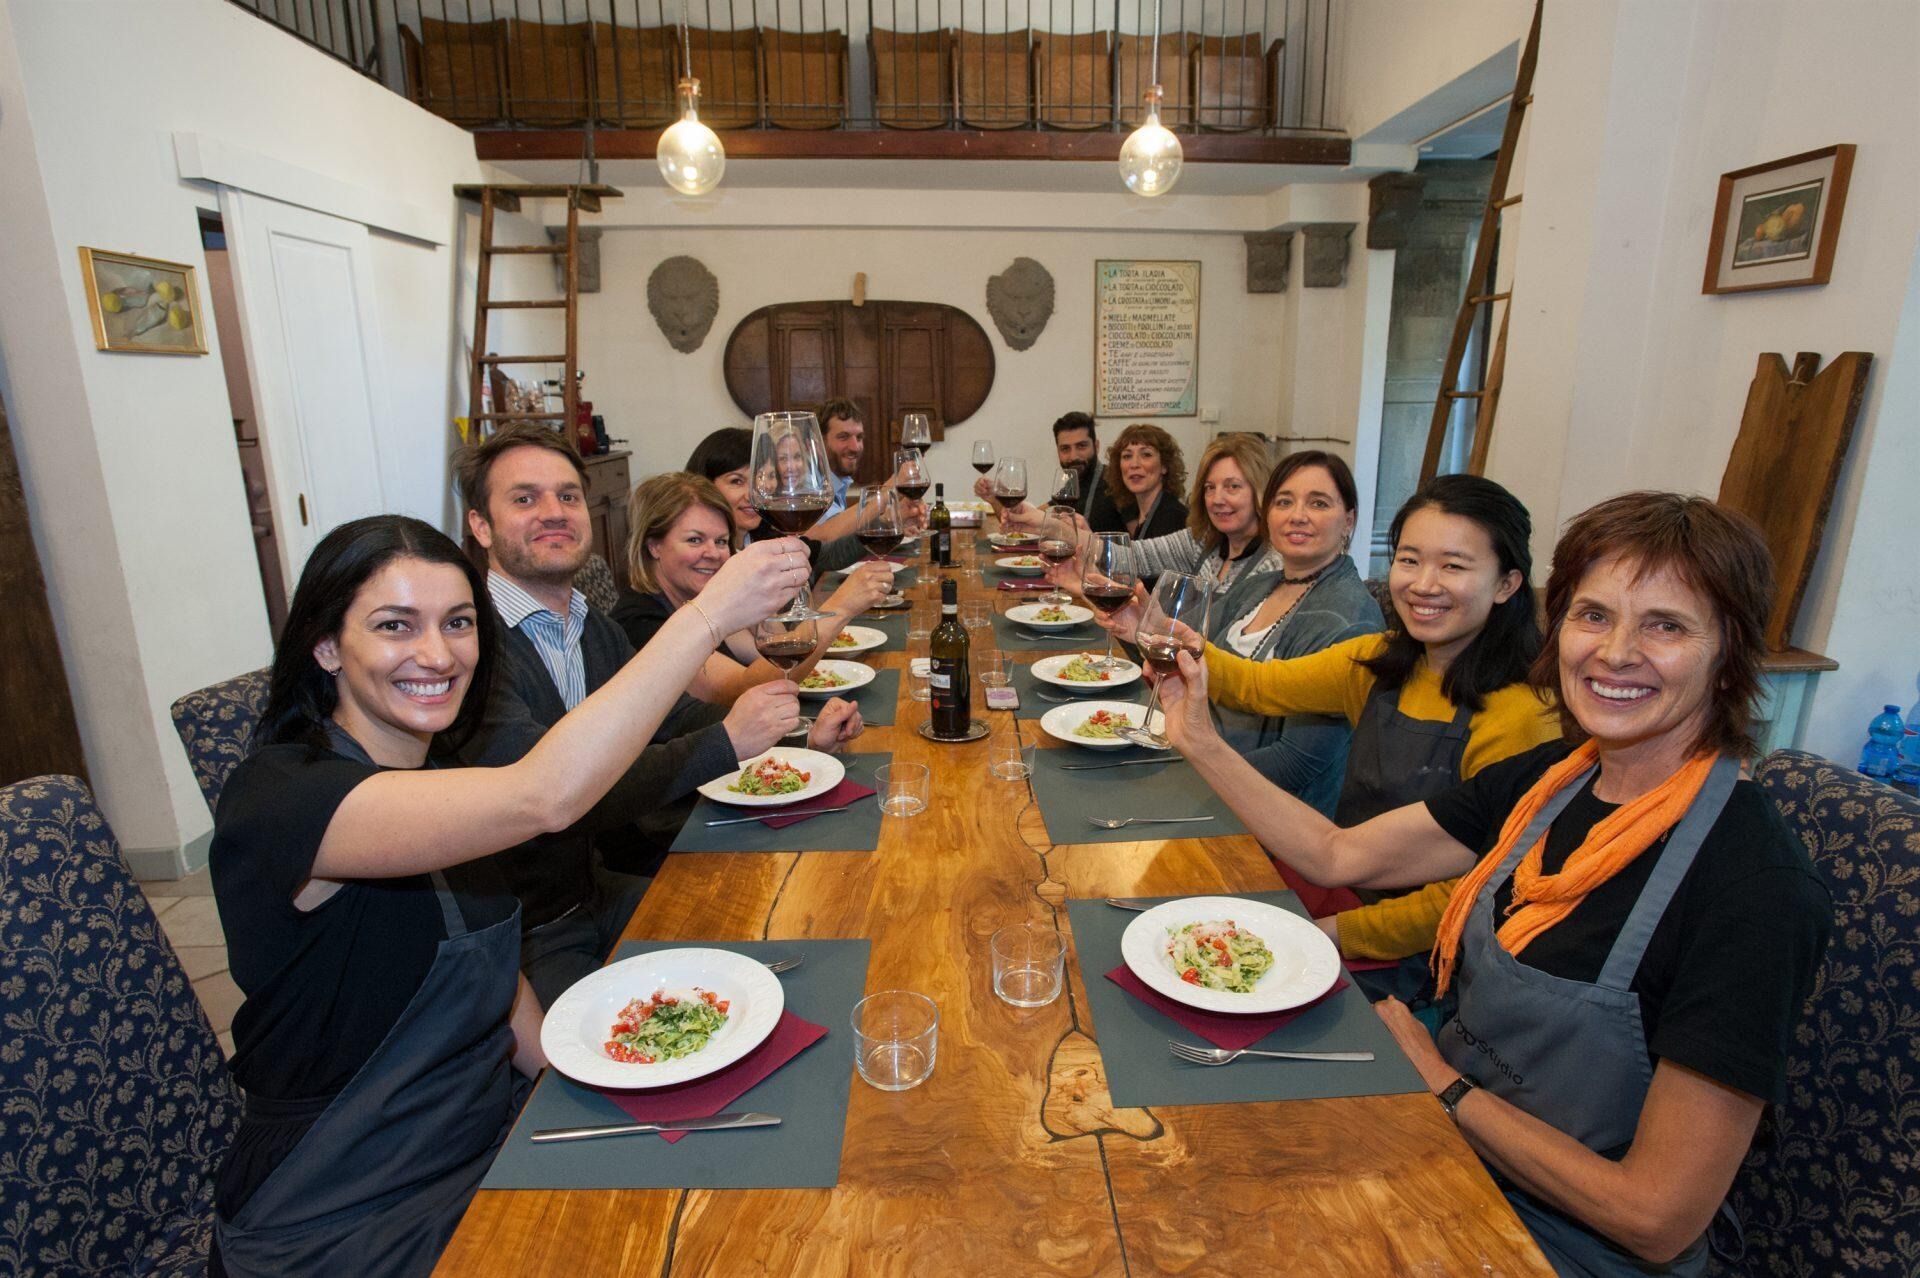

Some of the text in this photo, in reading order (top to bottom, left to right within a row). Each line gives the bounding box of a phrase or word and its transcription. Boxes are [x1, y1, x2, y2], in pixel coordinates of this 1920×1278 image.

[1120, 270, 1139, 278] TORTA
[1142, 270, 1166, 278] ILARIA
[1145, 284, 1184, 292] CIOCCOLATO
[1118, 297, 1144, 305] CROSTATA
[1150, 297, 1171, 305] LIMONI
[1108, 314, 1127, 322] MIELE
[1132, 314, 1176, 322] MARMELLATE
[1108, 322, 1133, 331] BISCOTTI
[1138, 322, 1166, 331] FROLLINI
[1108, 332, 1146, 340] CIOCCOLATO
[1151, 332, 1192, 340] CIOCCOLATINI
[1108, 340, 1129, 348] CREME
[1136, 340, 1174, 348] CIOCCOLATO
[1108, 376, 1134, 385] LIQUORI
[1108, 393, 1150, 401] CHAMPAGNE
